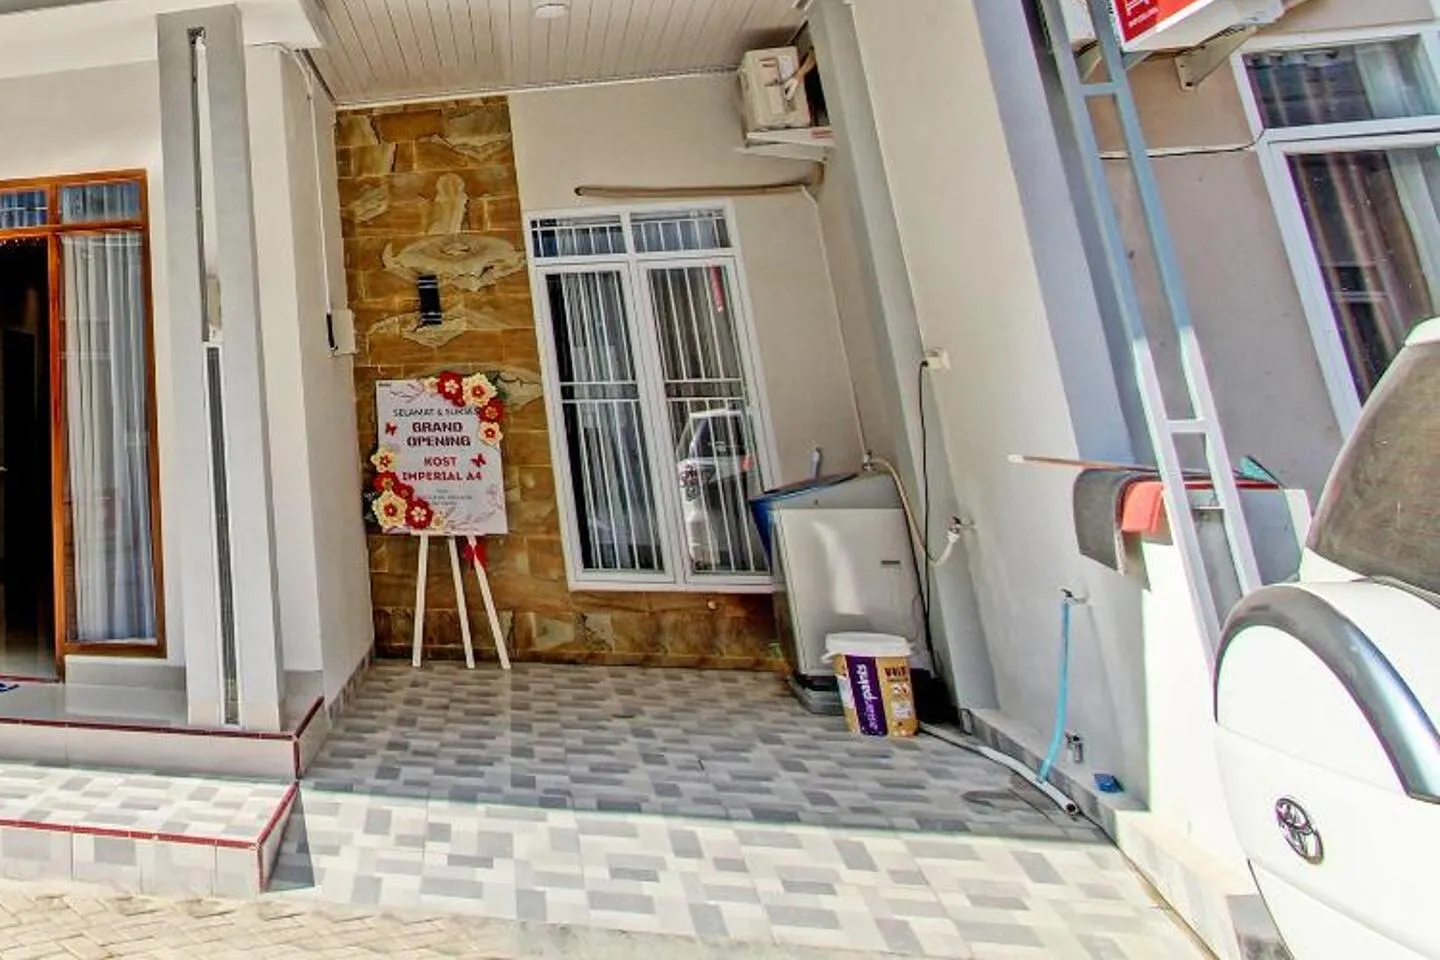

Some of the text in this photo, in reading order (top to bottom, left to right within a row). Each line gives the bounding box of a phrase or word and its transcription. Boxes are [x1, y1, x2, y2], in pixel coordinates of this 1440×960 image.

[412, 422, 463, 433] GRAND
[406, 435, 471, 447] OPENING
[424, 456, 457, 467] KOST
[402, 471, 462, 481] IMPERIAL
